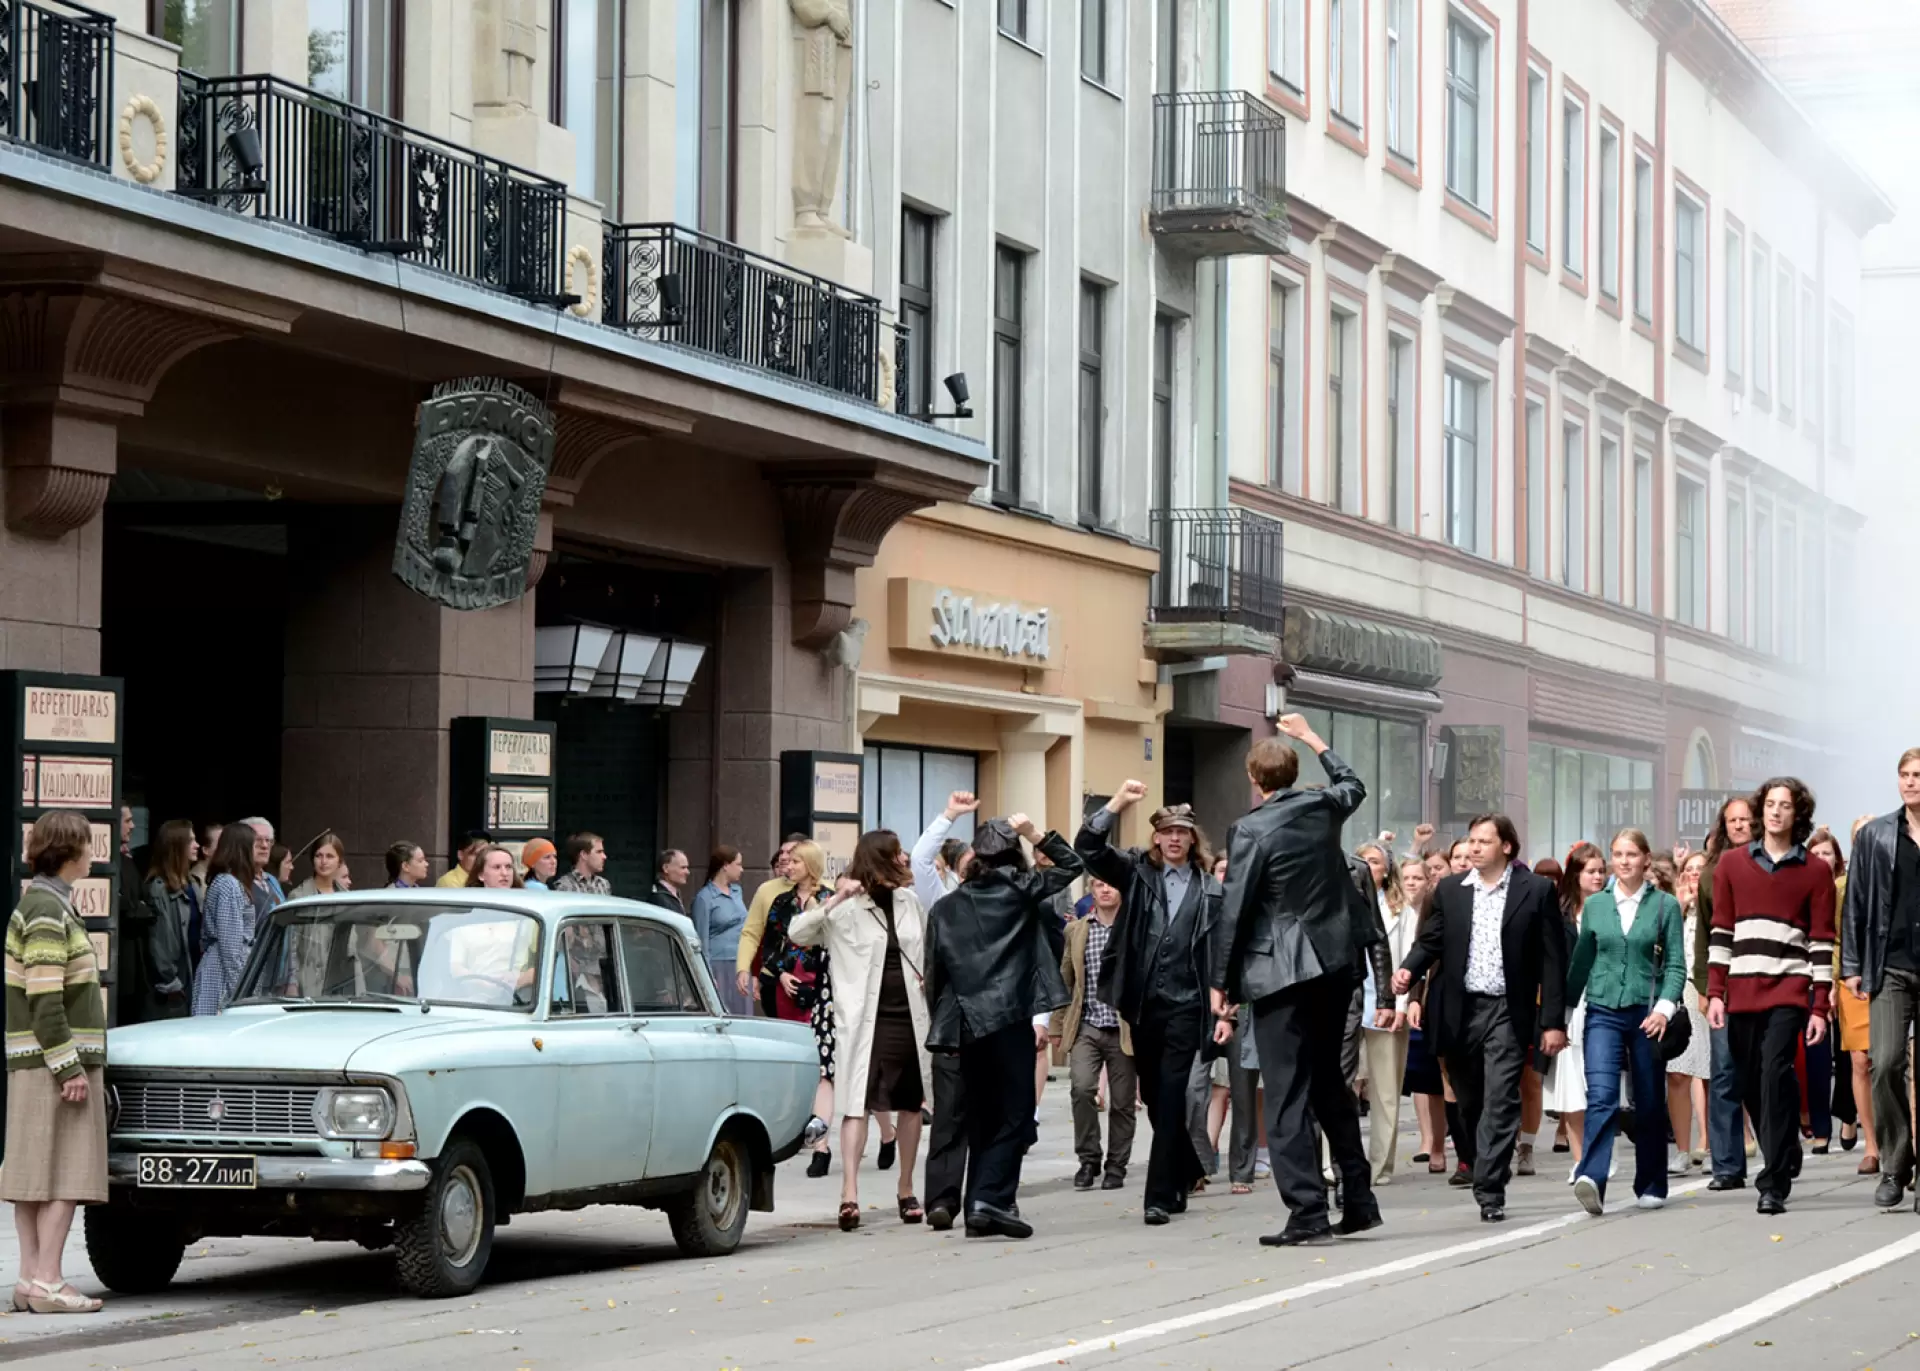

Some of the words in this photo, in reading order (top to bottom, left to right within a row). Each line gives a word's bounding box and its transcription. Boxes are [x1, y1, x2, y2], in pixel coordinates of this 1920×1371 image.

[31, 691, 109, 718] REPERTUARAS
[493, 732, 548, 755] REPERTUARAS
[40, 771, 110, 799] VAIDUOKLIAI
[141, 1157, 219, 1183] 88-27
